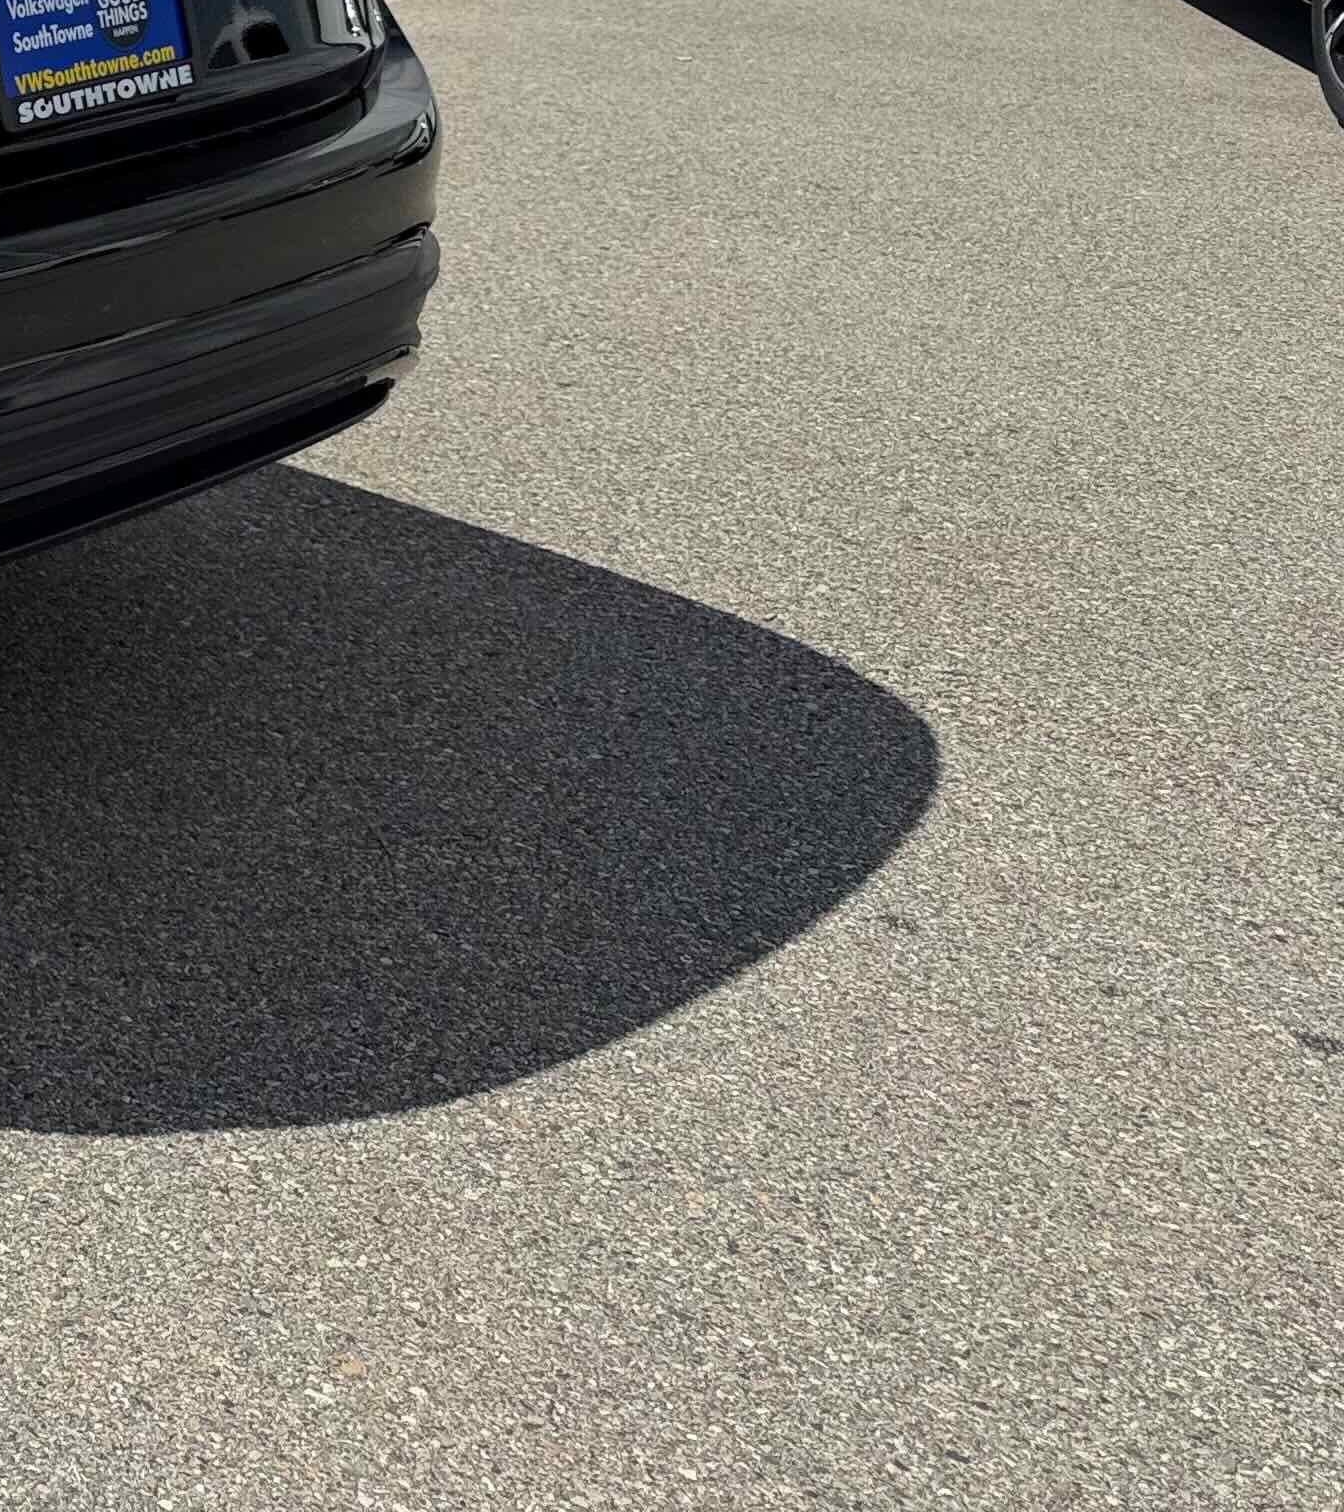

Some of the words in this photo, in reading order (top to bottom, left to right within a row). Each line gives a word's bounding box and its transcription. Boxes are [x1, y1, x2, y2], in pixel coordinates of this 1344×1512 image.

[96, 1, 148, 29] THINGS
[12, 22, 94, 53] SouthTowne
[14, 45, 176, 95] VWSouthtowne.com
[17, 64, 193, 124] SOUTHTOWNE
